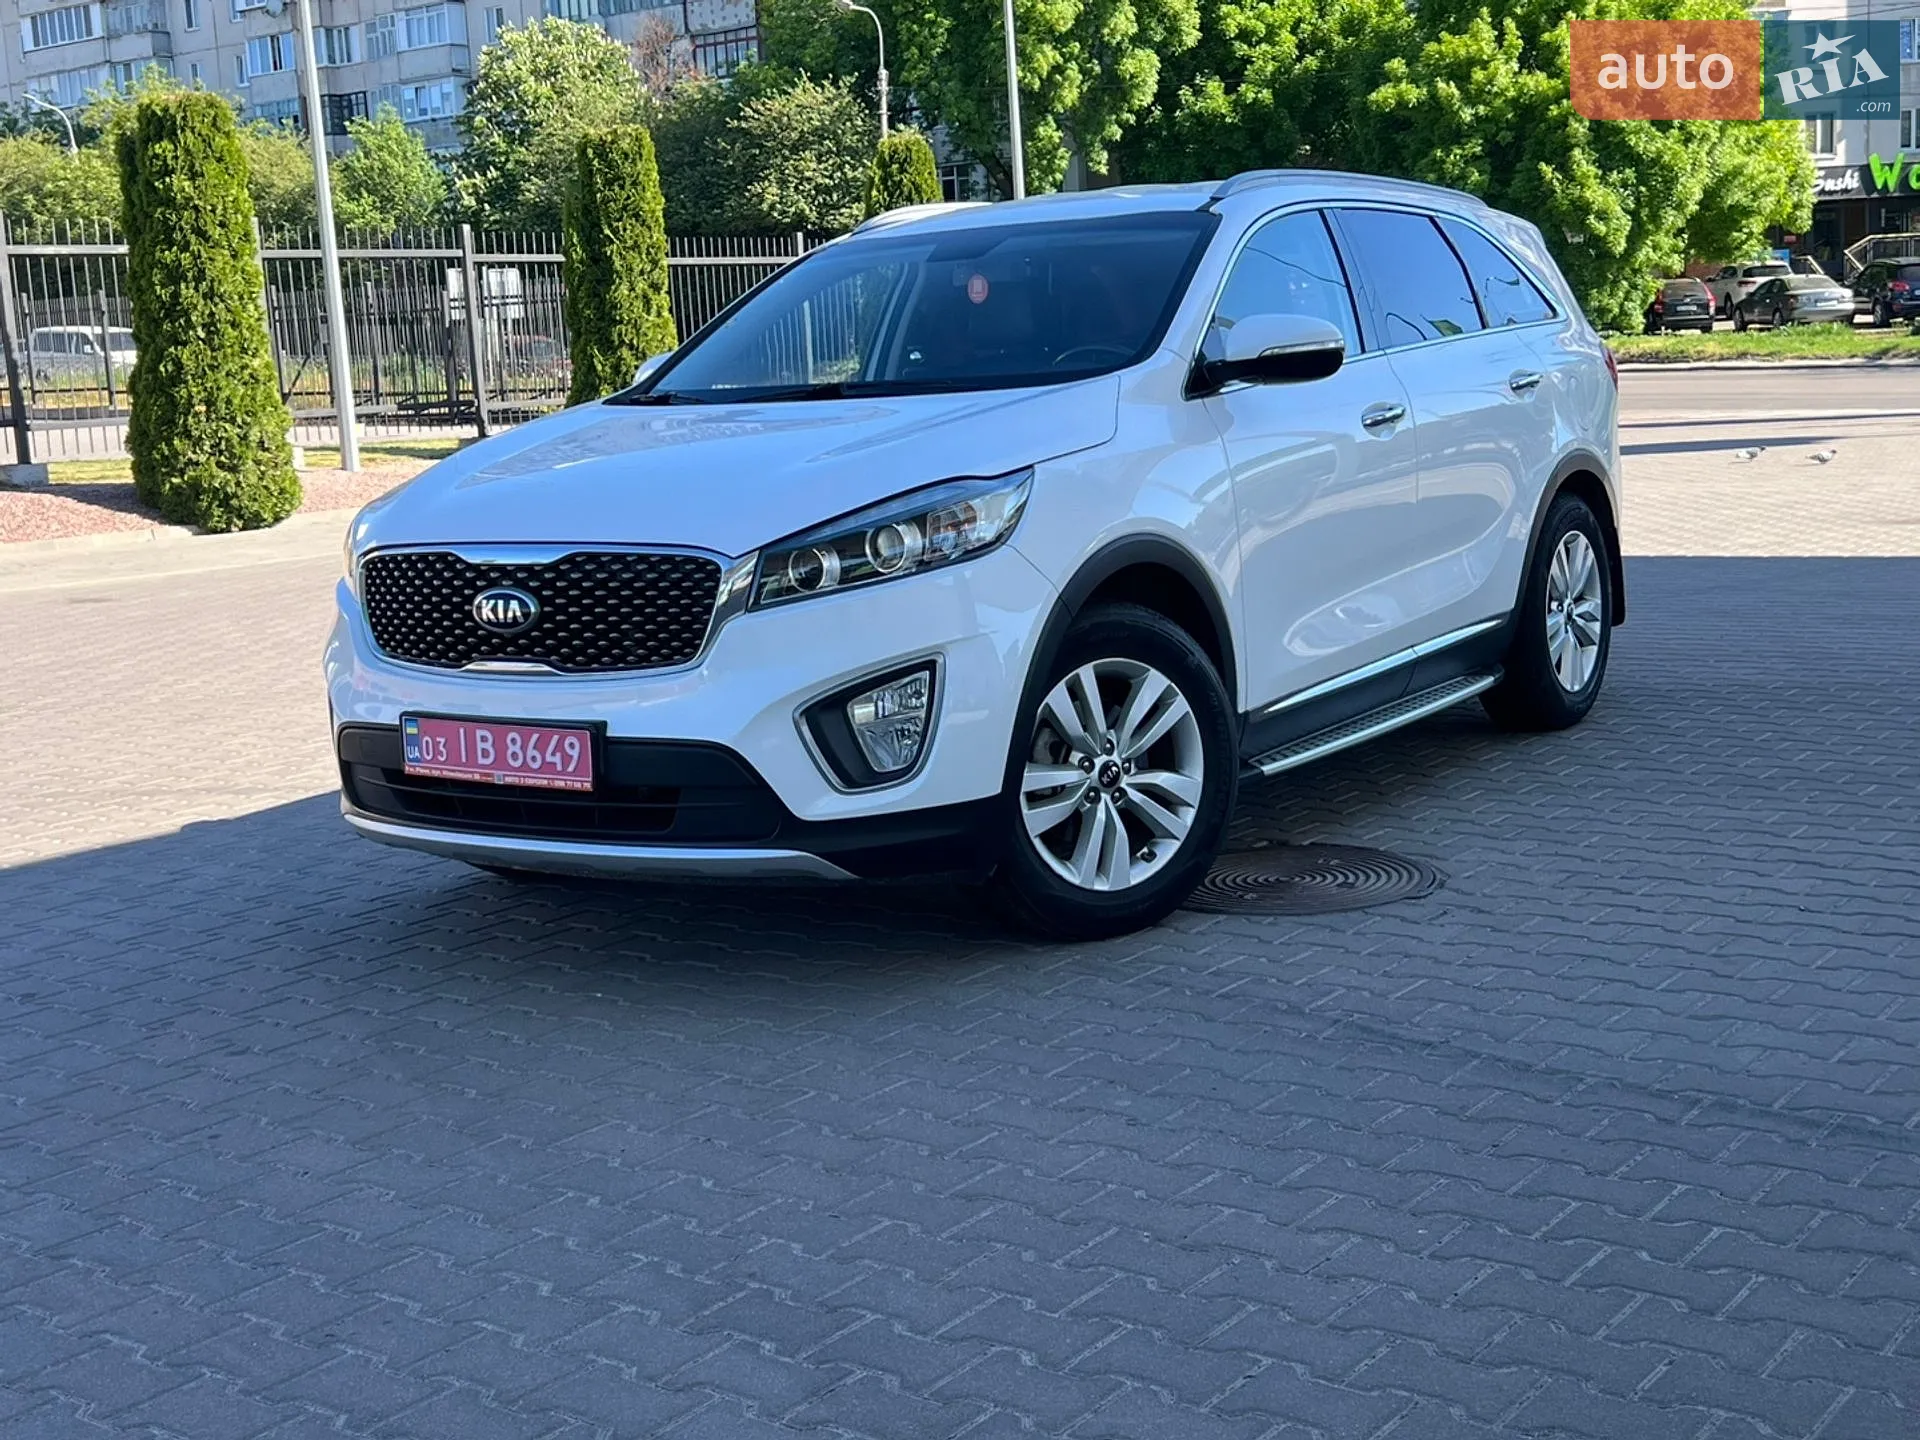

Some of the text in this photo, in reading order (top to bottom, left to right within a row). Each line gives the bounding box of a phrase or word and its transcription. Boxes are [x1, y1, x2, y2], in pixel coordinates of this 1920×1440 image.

[1808, 169, 1860, 193] Sushi
[481, 599, 525, 623] KIA
[407, 745, 421, 759] UA
[422, 735, 447, 762] 03
[506, 731, 581, 772] 8649
